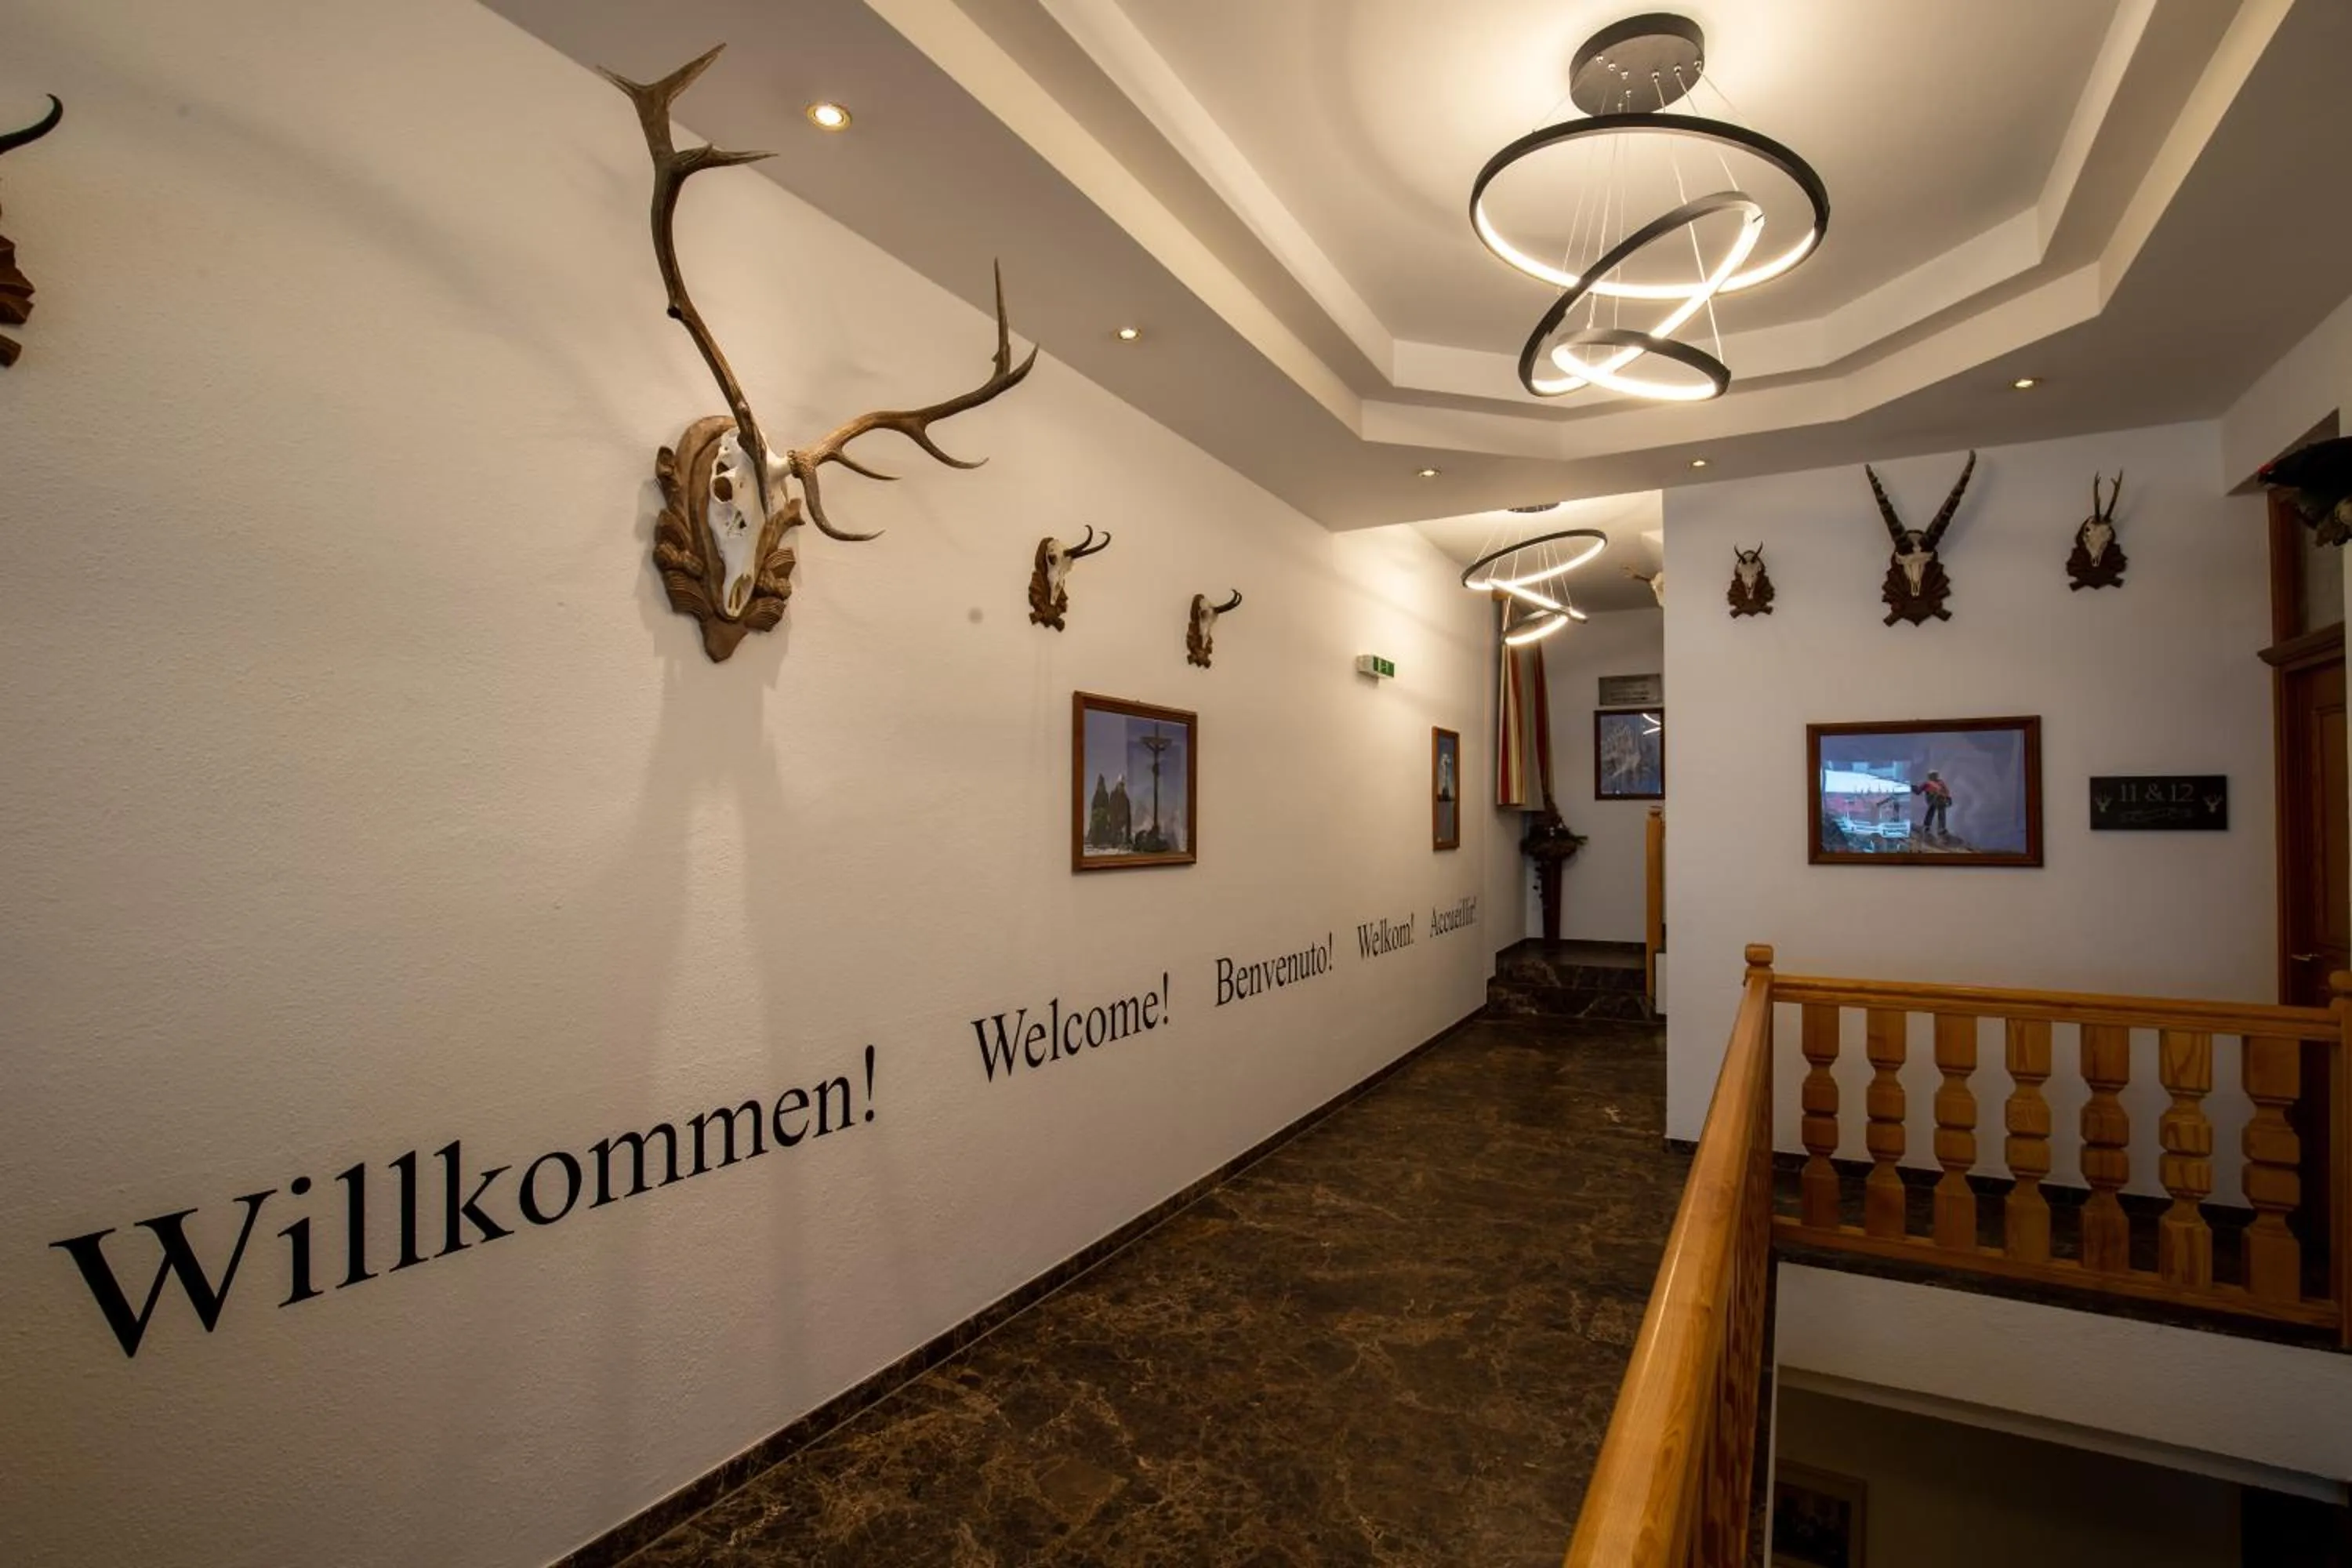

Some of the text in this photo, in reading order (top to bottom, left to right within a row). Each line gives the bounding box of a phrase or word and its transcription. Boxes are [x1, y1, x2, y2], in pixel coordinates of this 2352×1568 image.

[2118, 782, 2195, 802] 11 & 12
[49, 1045, 876, 1358] Willkommen!
[971, 971, 1169, 1083] Welcome!
[1215, 931, 1333, 1007] Benvenuto!
[1357, 912, 1414, 960] Welkom!
